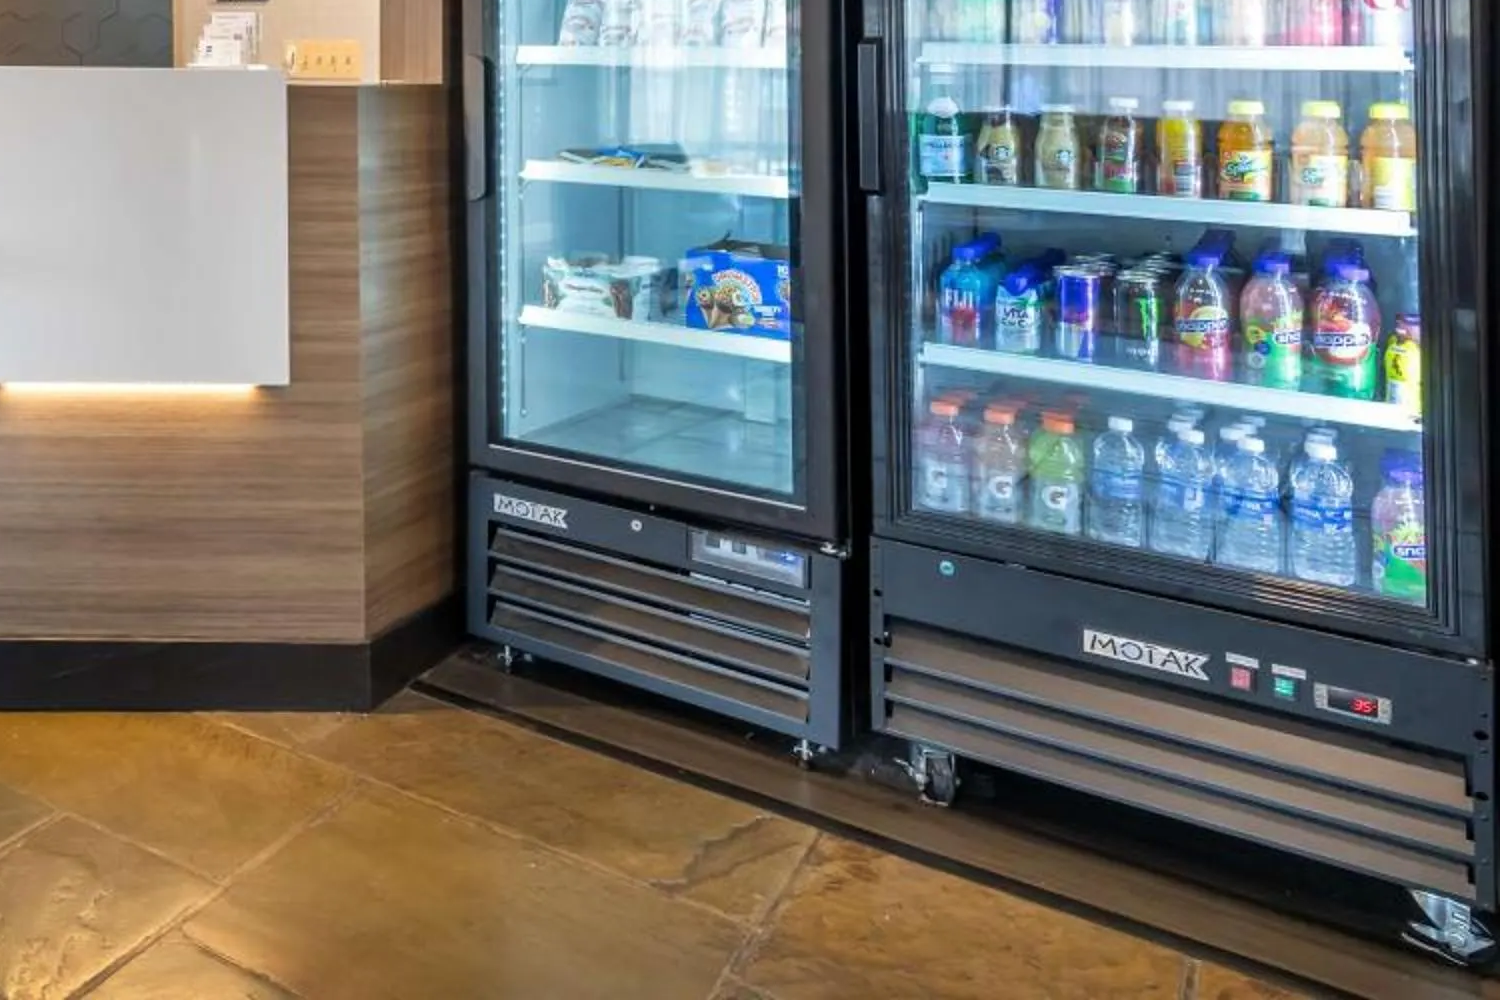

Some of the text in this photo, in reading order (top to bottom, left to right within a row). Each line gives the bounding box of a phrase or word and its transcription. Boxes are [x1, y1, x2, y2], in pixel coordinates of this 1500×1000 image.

[497, 497, 563, 526] MOTAK
[1041, 485, 1069, 511] G
[1089, 633, 1201, 677] MOTAK
